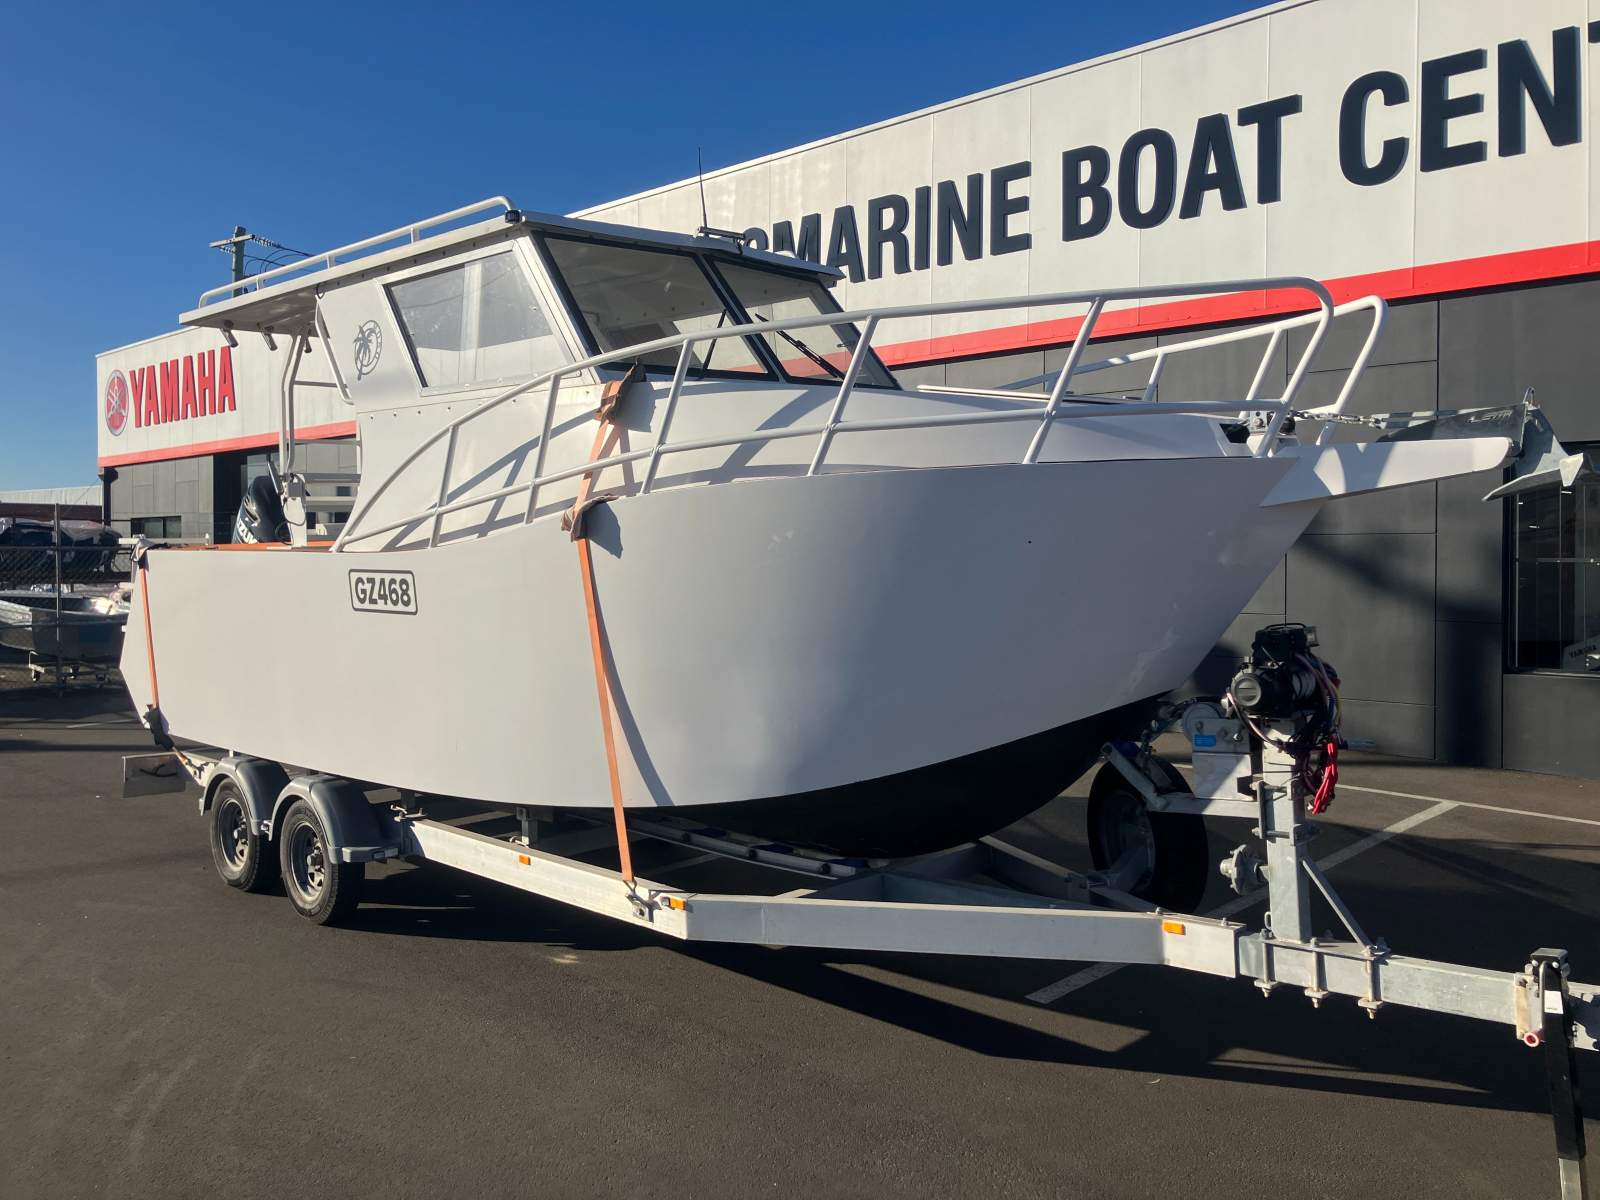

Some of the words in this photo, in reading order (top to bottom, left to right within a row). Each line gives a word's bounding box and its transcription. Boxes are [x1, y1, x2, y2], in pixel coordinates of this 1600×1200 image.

[1061, 93, 1303, 243] BOAT
[1338, 20, 1600, 187] CEN
[129, 345, 237, 428] YAMAHA
[354, 576, 412, 608] GZ468
